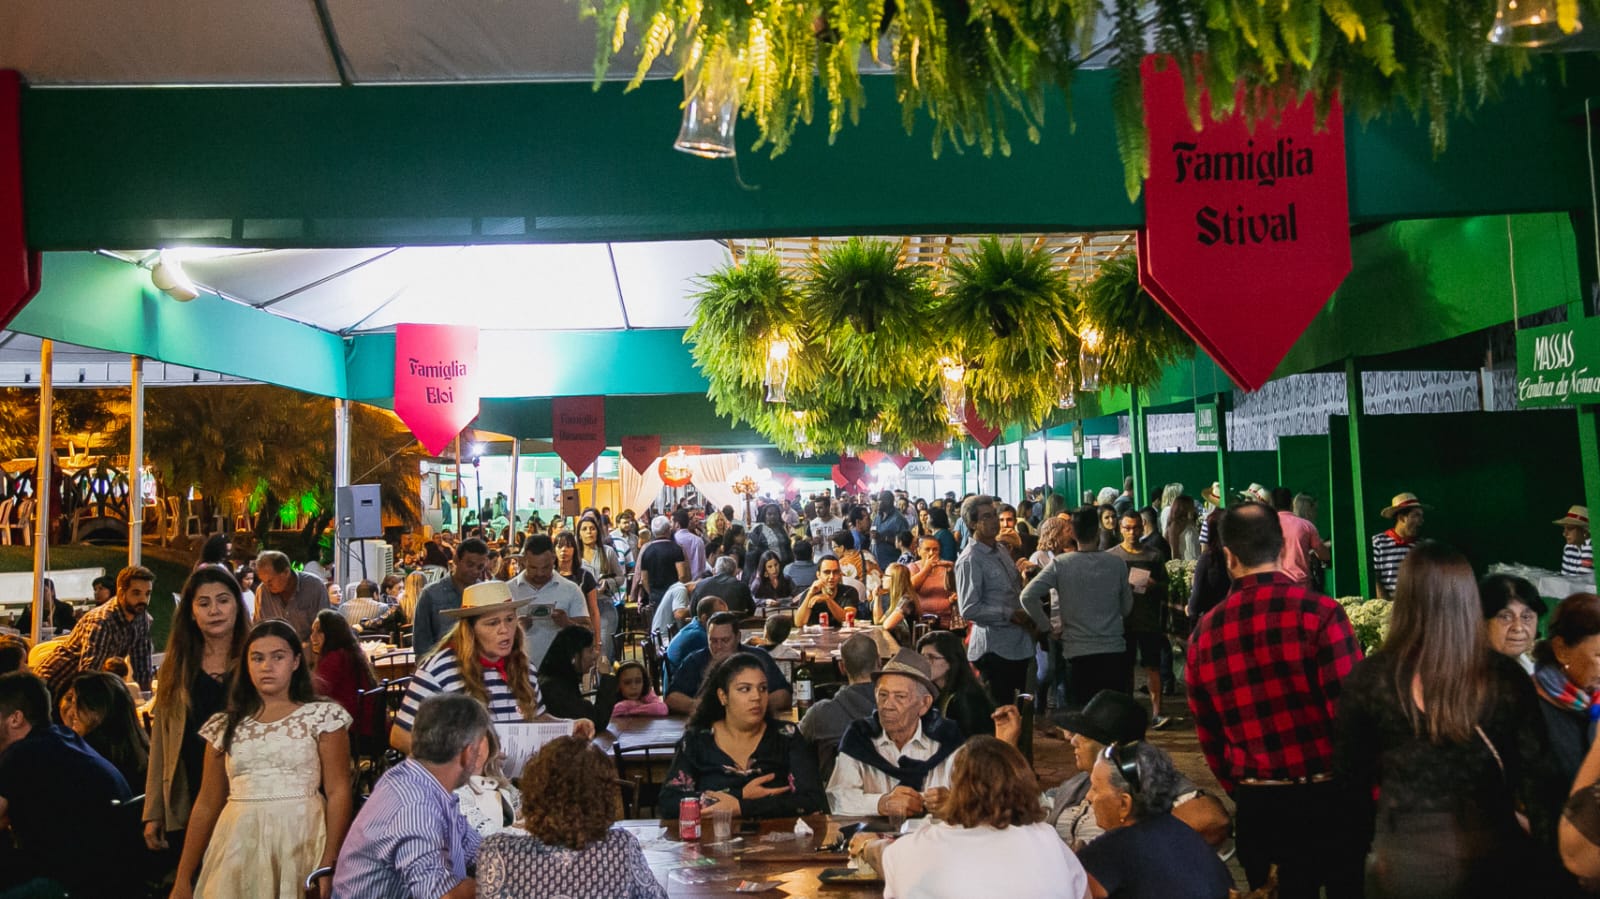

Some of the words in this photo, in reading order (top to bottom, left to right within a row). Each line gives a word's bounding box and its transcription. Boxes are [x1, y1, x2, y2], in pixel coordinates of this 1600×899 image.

[1172, 137, 1314, 186] Famiglia
[1196, 202, 1298, 246] Stival
[1533, 329, 1575, 372] MASSAS
[409, 357, 466, 380] Famiglia
[426, 386, 453, 404] Eloi
[1518, 375, 1555, 401] Cantina
[1555, 372, 1569, 396] da
[908, 464, 932, 473] CAIXA
